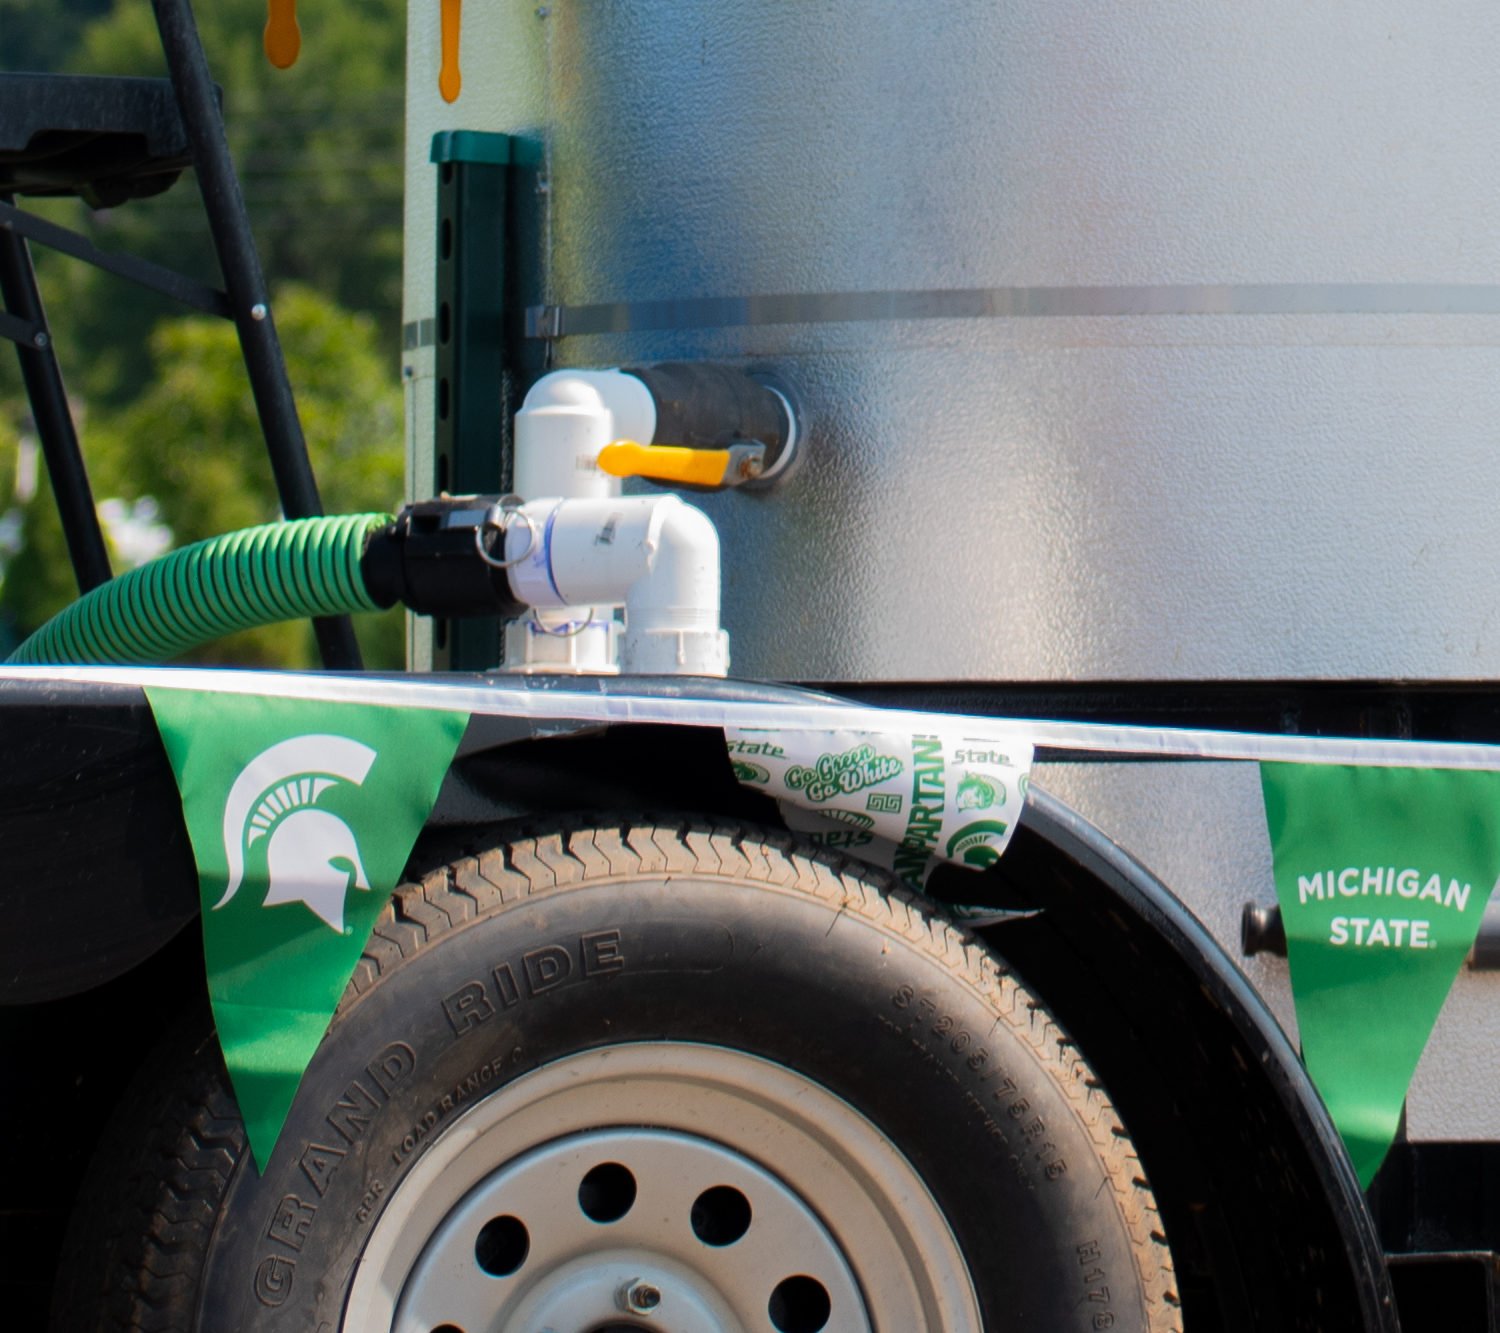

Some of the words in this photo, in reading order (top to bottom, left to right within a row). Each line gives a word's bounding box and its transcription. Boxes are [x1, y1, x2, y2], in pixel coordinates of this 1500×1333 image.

[784, 765, 818, 790] Go
[816, 743, 876, 784] Green
[806, 778, 840, 802] Go
[838, 757, 904, 794] White
[951, 749, 1018, 768] State
[1299, 867, 1471, 913] MICHIGAN
[1330, 917, 1430, 949] STATE
[253, 1039, 418, 1309] GRAND
[441, 929, 627, 1039] RIDE
